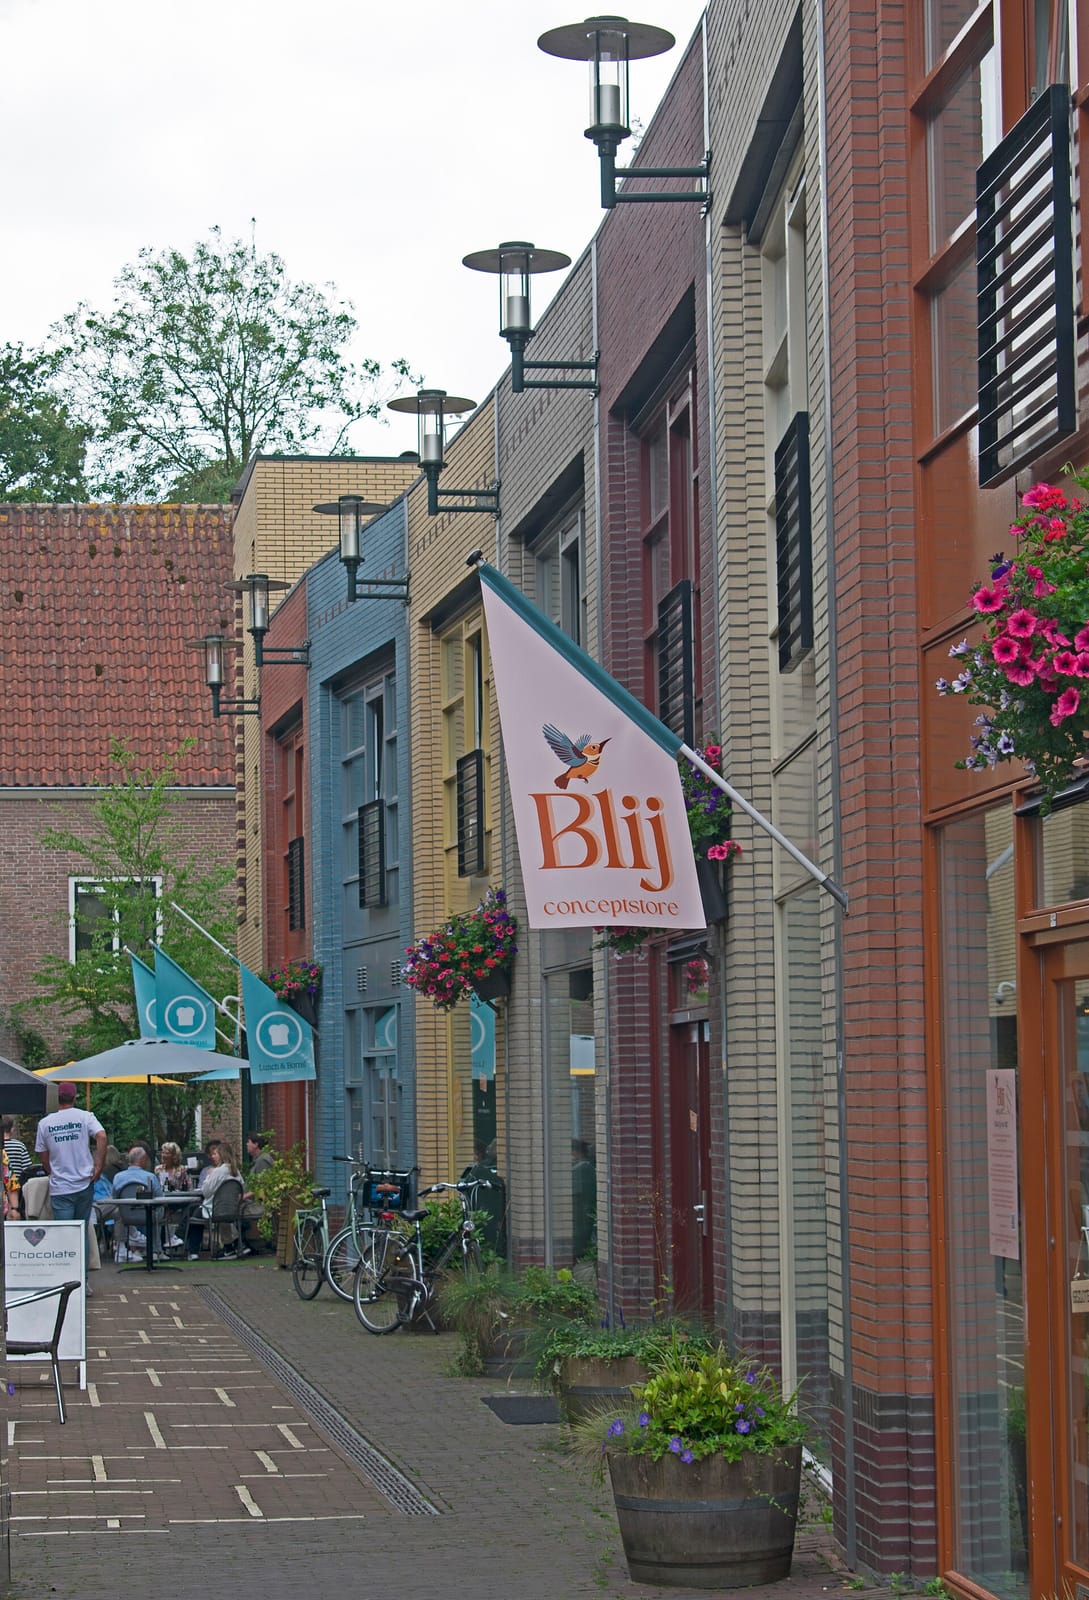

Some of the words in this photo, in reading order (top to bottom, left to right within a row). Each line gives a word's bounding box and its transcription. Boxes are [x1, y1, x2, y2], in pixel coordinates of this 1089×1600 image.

[528, 787, 675, 892] Blij
[543, 897, 680, 918] conceptstore
[48, 1121, 82, 1133] baseline
[54, 1133, 79, 1143] tennis
[9, 1250, 77, 1259] Chocolate
